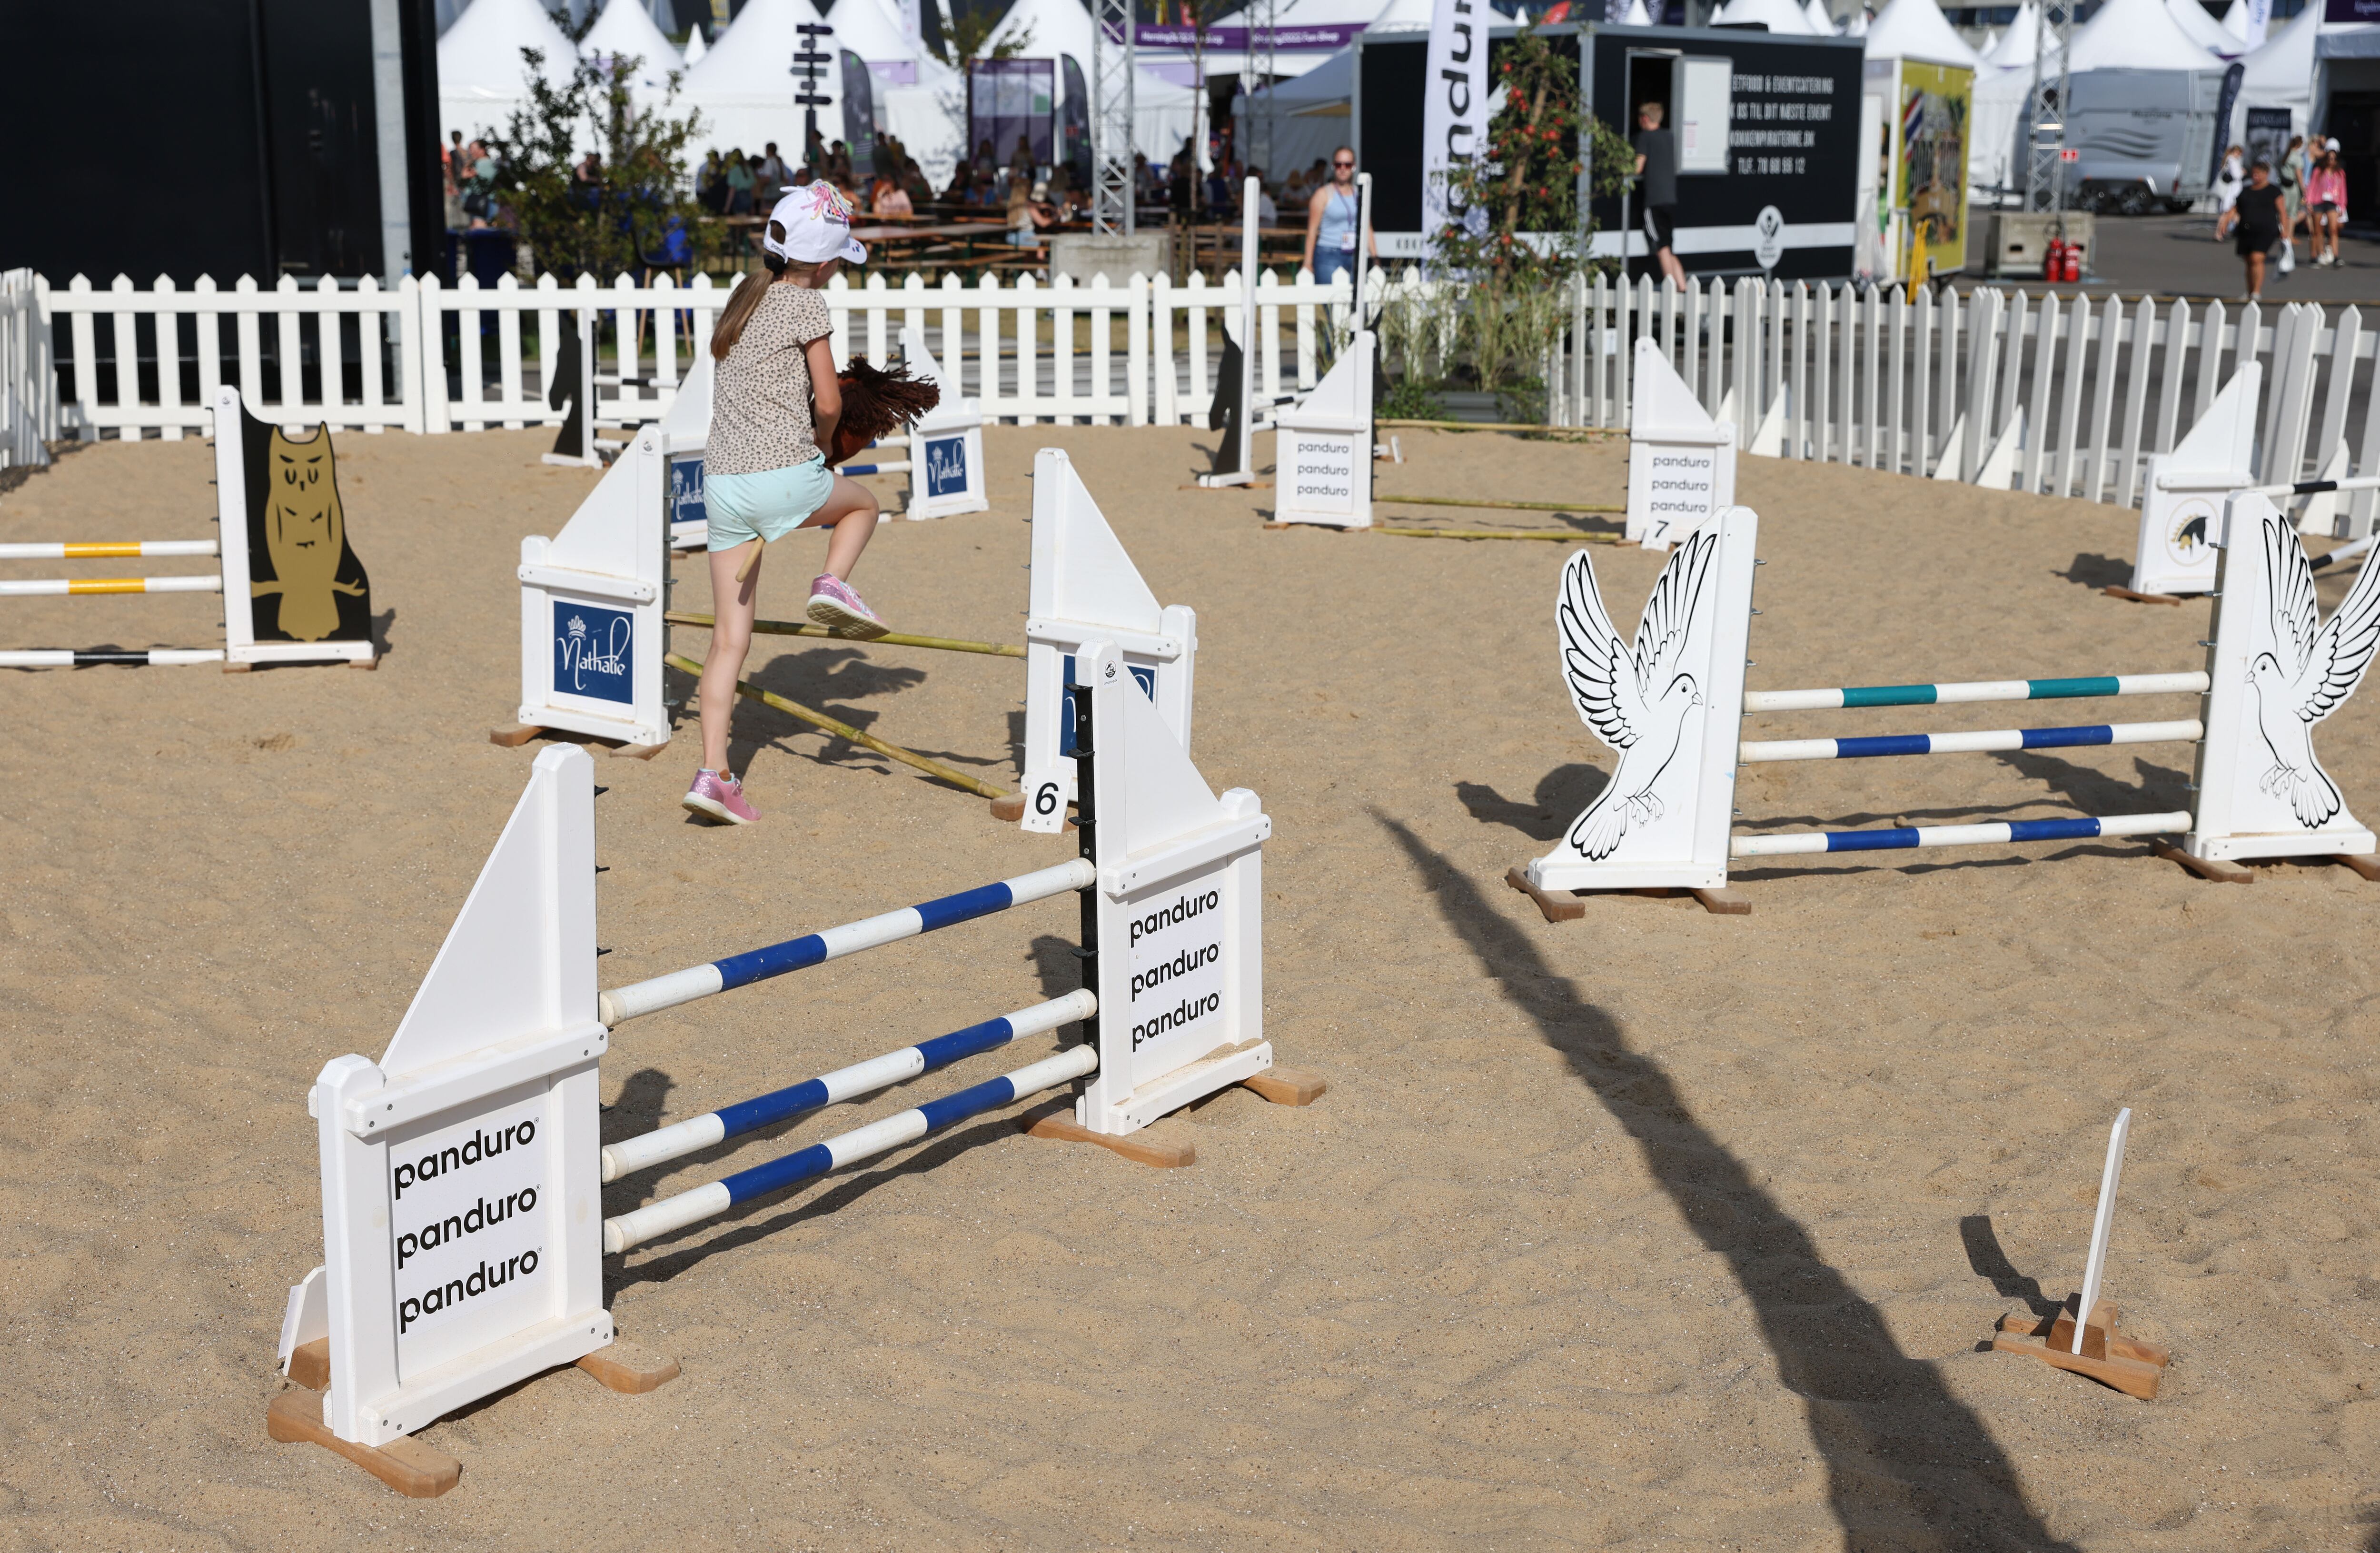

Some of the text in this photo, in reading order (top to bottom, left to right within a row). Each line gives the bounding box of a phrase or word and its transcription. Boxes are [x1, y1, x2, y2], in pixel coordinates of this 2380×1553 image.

[1772, 75, 1834, 94] EVENTCATERING
[1749, 102, 1763, 120] TIL
[1807, 103, 1832, 121] EVENT
[1297, 442, 1349, 454] panduro
[1653, 456, 1710, 469] panduro
[1297, 465, 1349, 477] panduro
[1297, 485, 1349, 496] panduro
[1651, 479, 1709, 492] panduro
[1650, 501, 1707, 513] panduro
[1656, 520, 1669, 538] 7
[556, 617, 631, 690] Nathalie
[1035, 782, 1059, 815] 6
